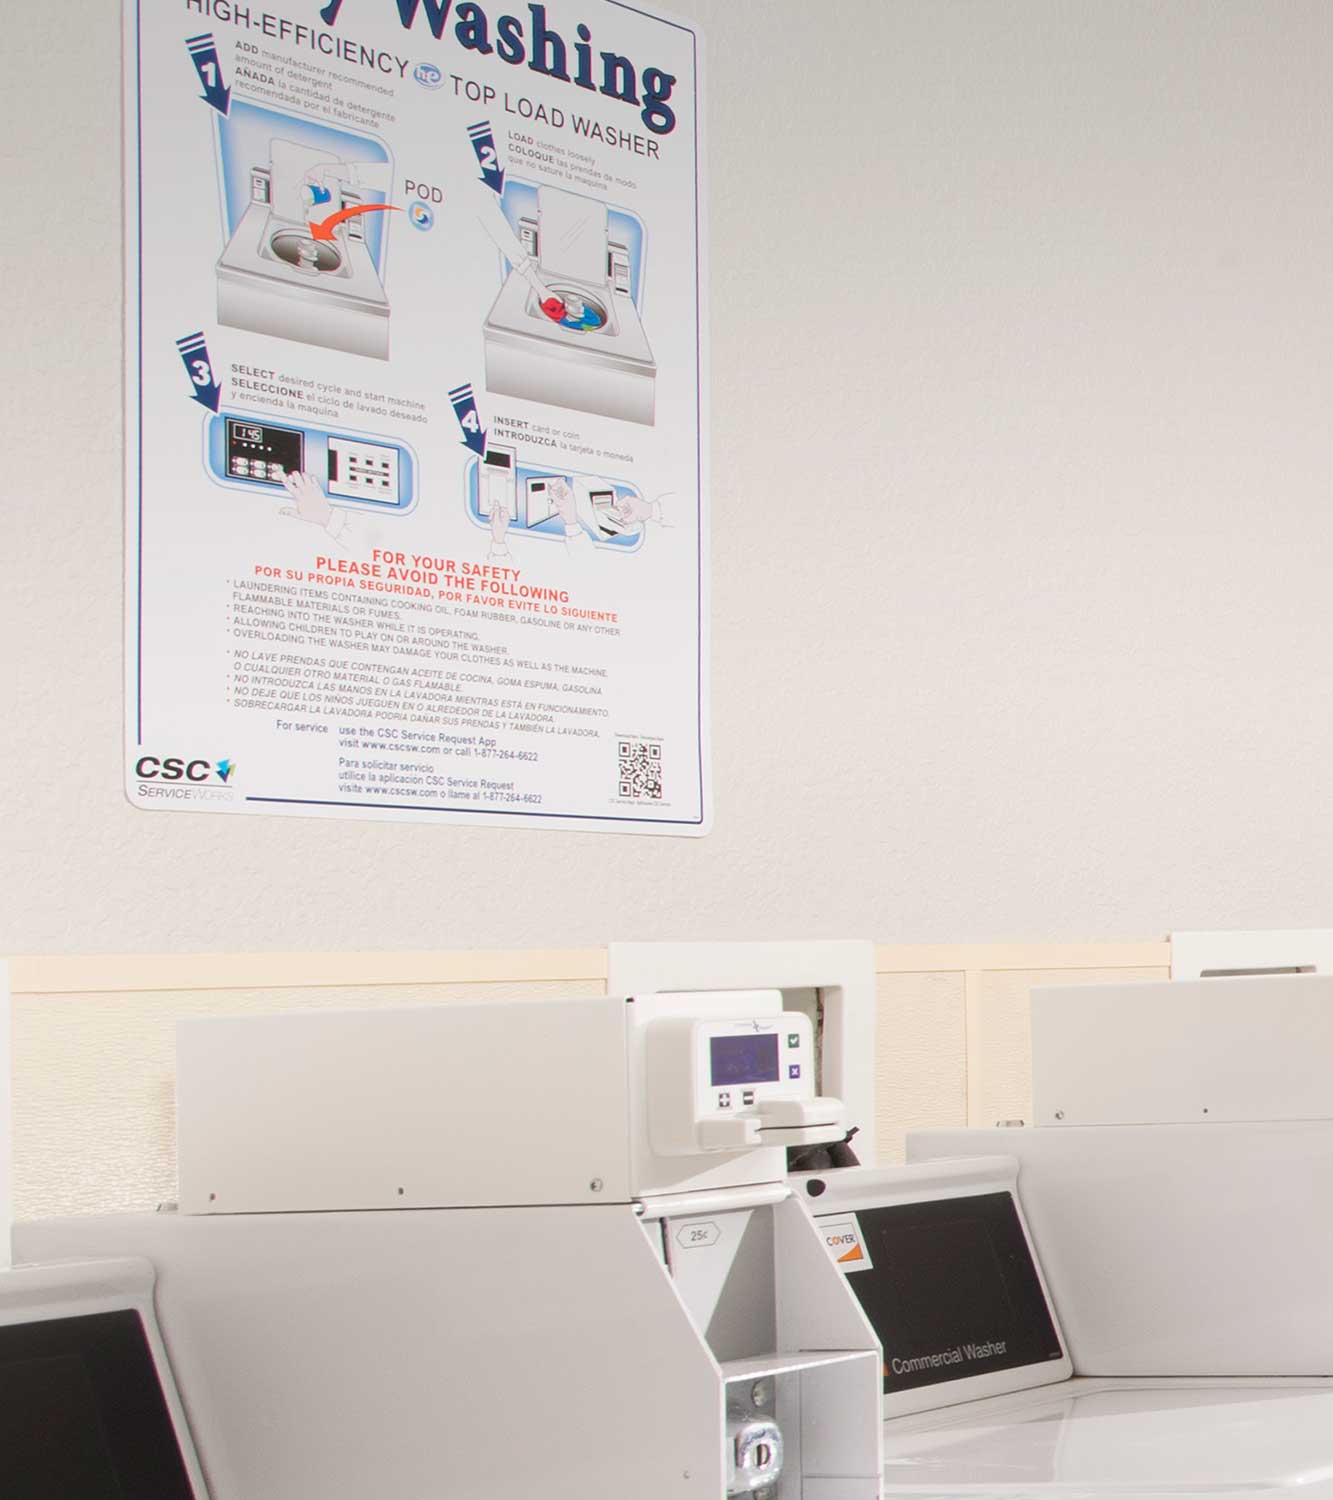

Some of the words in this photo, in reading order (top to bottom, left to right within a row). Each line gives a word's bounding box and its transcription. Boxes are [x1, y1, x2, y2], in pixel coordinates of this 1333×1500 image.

[186, 0, 409, 78] HIGH-EFFICIENCY
[450, 75, 496, 105] TOP
[504, 92, 565, 129] LOAD
[571, 114, 661, 160] WASHER
[201, 61, 217, 88] 1
[396, 0, 677, 135] Washing
[480, 146, 498, 171] 2
[404, 179, 443, 204] POD
[191, 360, 210, 387] 3
[461, 409, 479, 433] 4
[372, 549, 405, 566] FOR
[412, 555, 456, 573] YOUR
[461, 562, 519, 582] SAFETY
[315, 557, 381, 578] PLEASE
[387, 566, 438, 585] AVOID
[444, 574, 475, 590] THE
[480, 579, 568, 603] FOLLOWING
[232, 592, 293, 607] FLAMMABLE
[295, 599, 350, 614] MATERIALS
[352, 606, 366, 616] OR
[254, 565, 281, 578] POR
[285, 570, 303, 581] SU
[307, 572, 355, 588] PROPIA
[437, 590, 462, 602] POR
[465, 594, 504, 608] FAVOR
[507, 599, 540, 612] EVITE
[543, 604, 558, 615] LO
[560, 606, 617, 623] SIGUIENTE
[233, 604, 285, 618] REACHING
[287, 610, 310, 621] INTO
[313, 613, 331, 623] THE
[333, 616, 374, 628] WASHER
[376, 621, 405, 632] WHILE
[407, 624, 415, 633] IT
[416, 626, 426, 634] IS
[276, 720, 292, 730] For
[294, 722, 328, 734] service
[338, 727, 356, 736] use
[358, 727, 374, 738] the
[376, 728, 398, 739] CSC
[400, 730, 436, 742] Service
[437, 733, 476, 747] Request
[478, 736, 496, 748] App
[338, 738, 359, 749] visit
[361, 742, 441, 755] www.cscsw.com
[442, 747, 452, 756] or
[454, 746, 471, 757] call
[135, 756, 211, 782] CSC
[338, 757, 360, 768] Para
[361, 759, 397, 771] solicitar
[399, 761, 434, 773] servicio
[338, 784, 363, 794] visite
[364, 787, 438, 798] www.cscsw.com
[447, 789, 471, 800] llame
[472, 790, 480, 800] al
[826, 1233, 857, 1248] COVER
[892, 1348, 962, 1375] Commercial
[962, 1340, 1007, 1362] Washer
